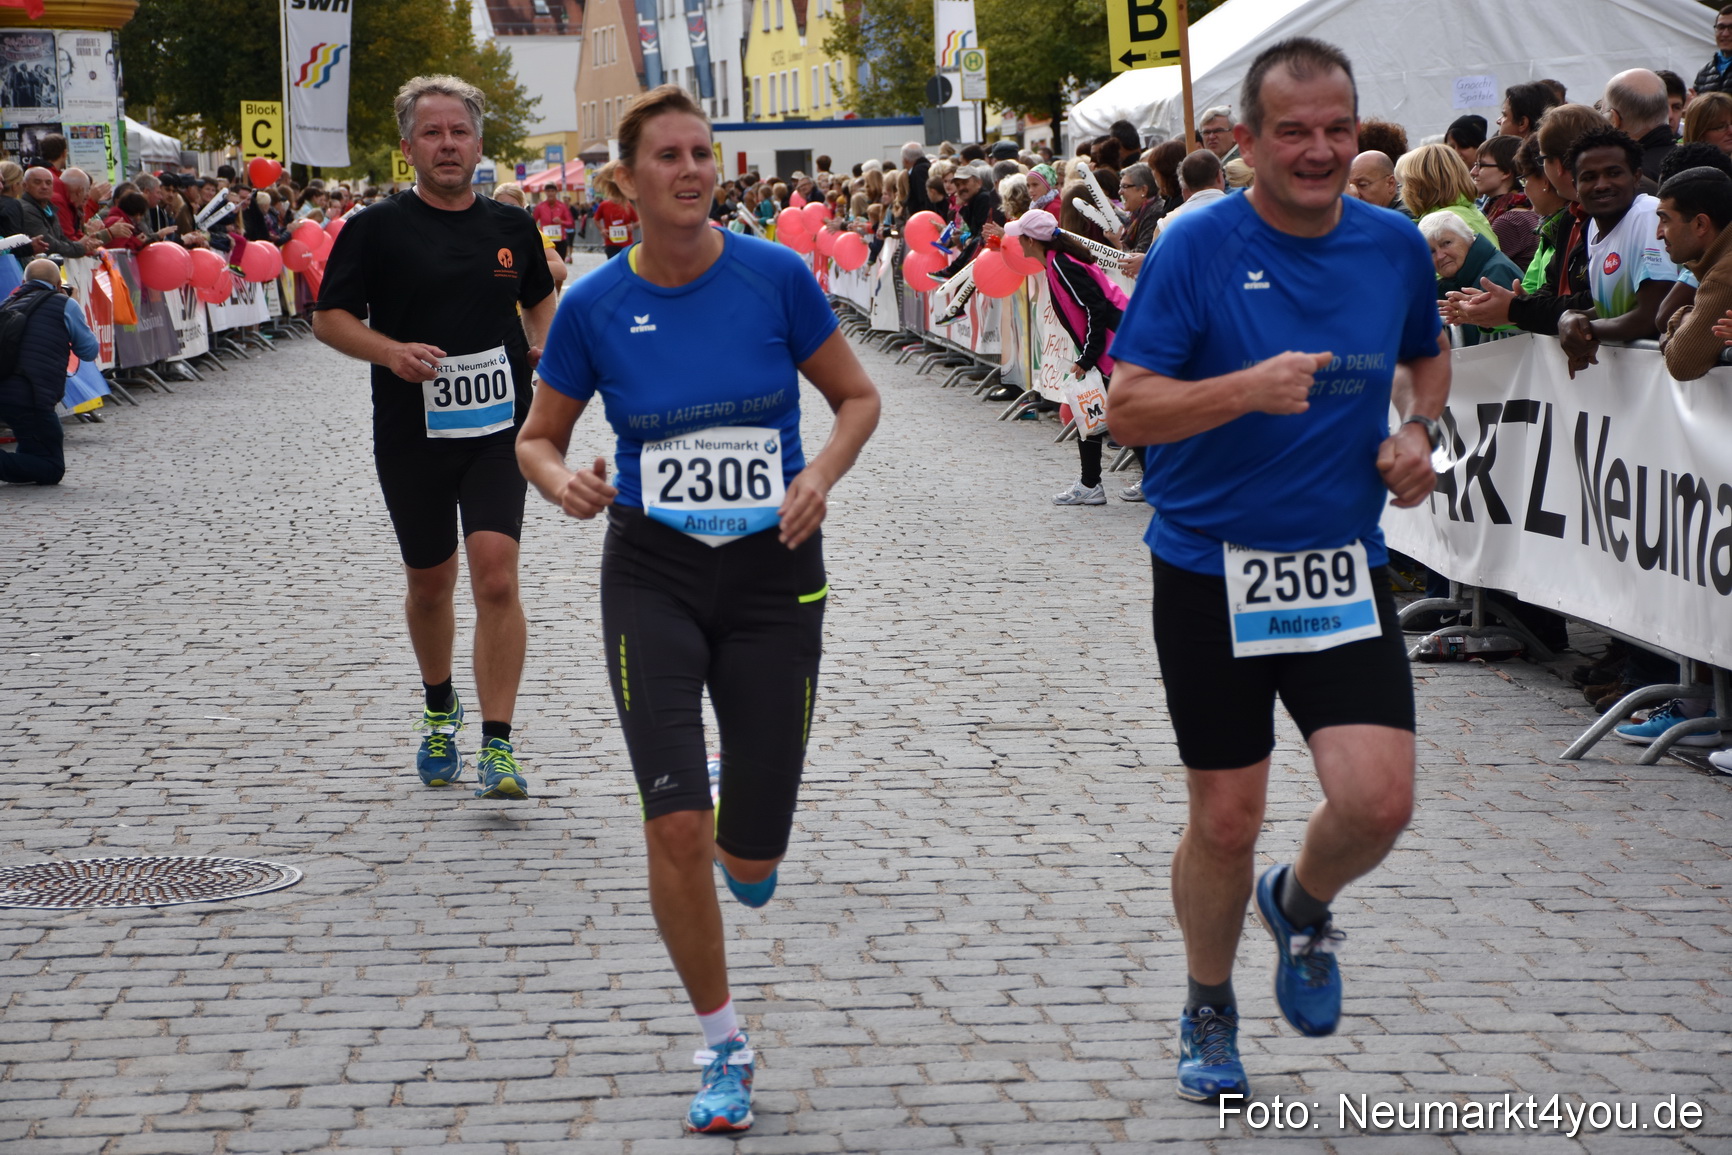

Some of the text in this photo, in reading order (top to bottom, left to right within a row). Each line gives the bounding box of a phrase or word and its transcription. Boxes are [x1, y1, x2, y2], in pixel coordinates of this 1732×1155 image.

[1128, 0, 1168, 43] B
[1456, 77, 1492, 90] Gnocchi
[1459, 90, 1494, 104] Spätzle
[245, 103, 278, 116] Block
[251, 119, 273, 149] C
[398, 160, 409, 175] D
[1243, 281, 1271, 290] erima
[629, 324, 657, 334] erima
[457, 358, 498, 372] Neumarkt
[433, 369, 508, 408] 3000
[1076, 388, 1100, 402] Müller
[1329, 379, 1367, 395] SICH
[628, 413, 661, 430] WER
[666, 401, 737, 426] LAUFEND
[1087, 403, 1104, 420] M
[646, 439, 760, 453] PARTL Neumarkt
[658, 457, 772, 503] 2306
[1574, 411, 1732, 597] Neuma
[684, 515, 748, 532] Andrea
[1243, 551, 1357, 605] 2569
[1268, 615, 1342, 636] Andreas
